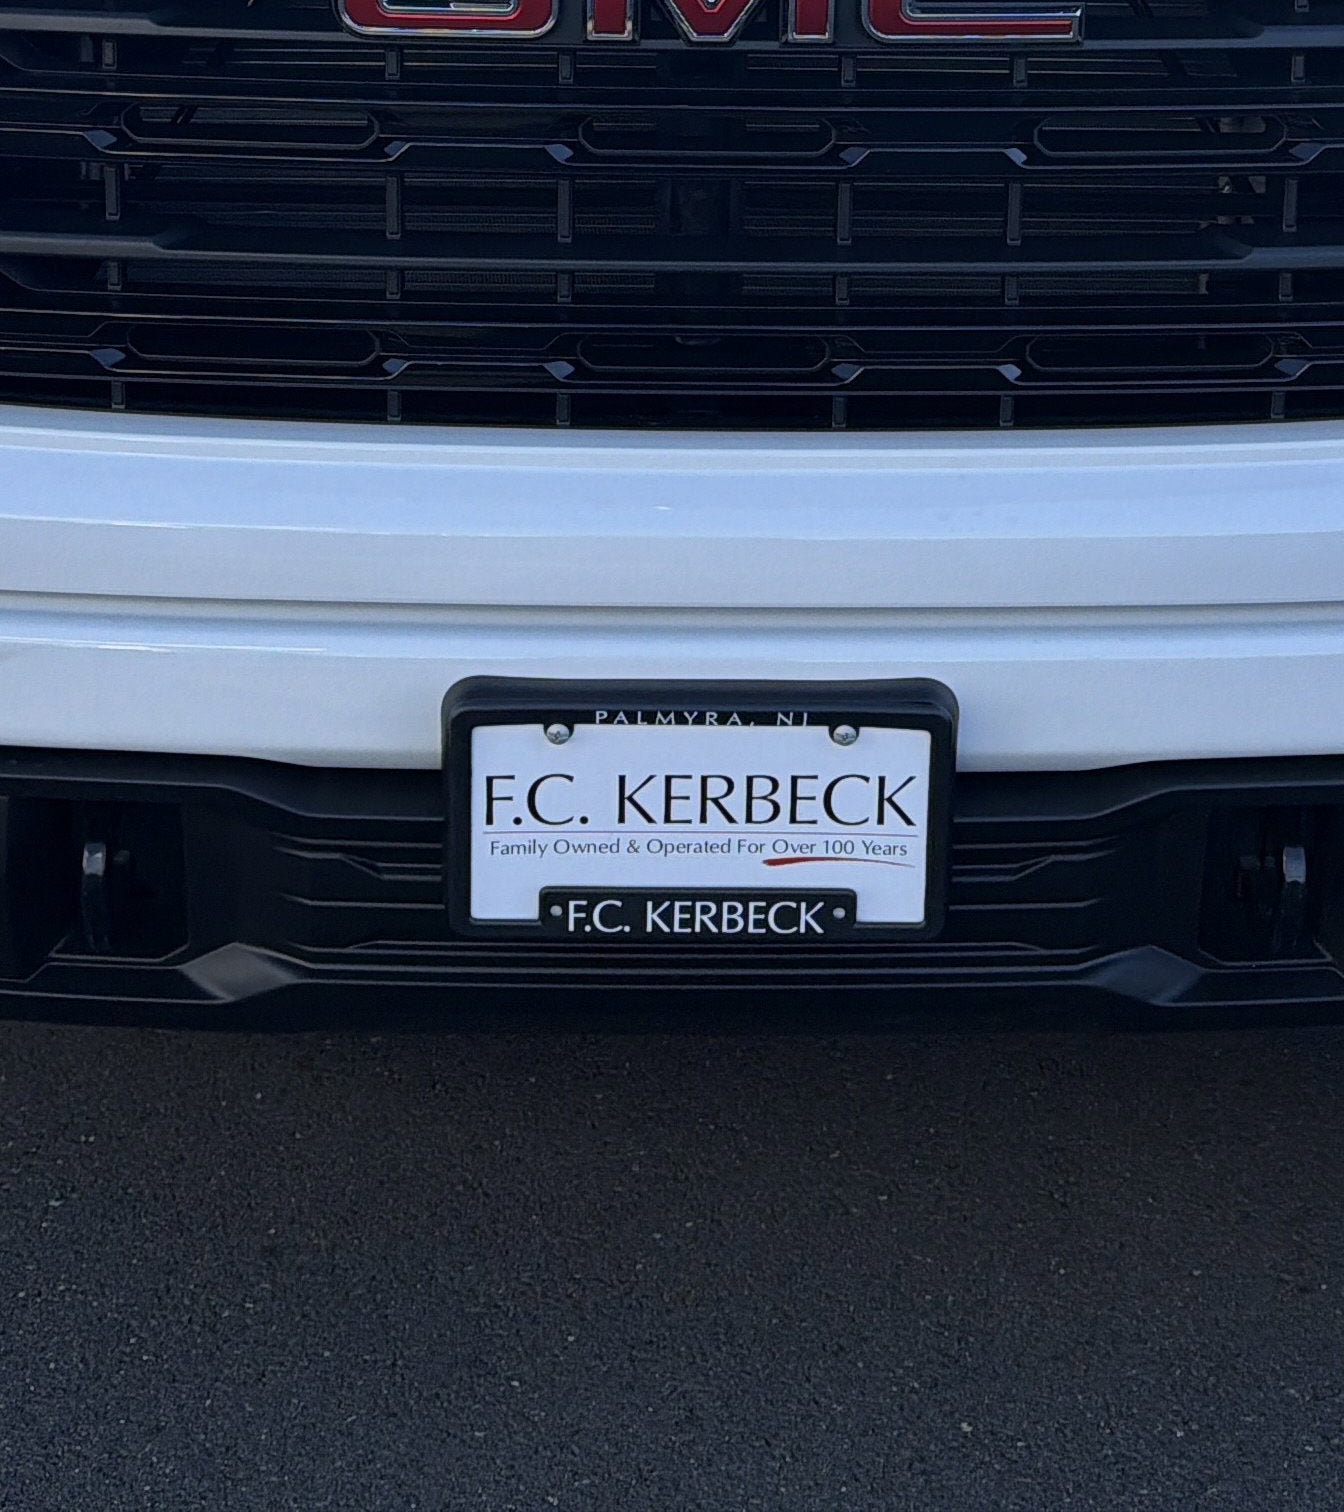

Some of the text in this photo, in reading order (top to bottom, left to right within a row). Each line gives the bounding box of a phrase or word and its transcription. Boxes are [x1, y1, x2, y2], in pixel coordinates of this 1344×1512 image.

[594, 710, 755, 727] PALMYRA,
[485, 773, 917, 828] F.C. KERBECK
[490, 838, 908, 859] Family Owned & Operated For Over 100 Years
[567, 899, 825, 936] F.C. KERBECK
